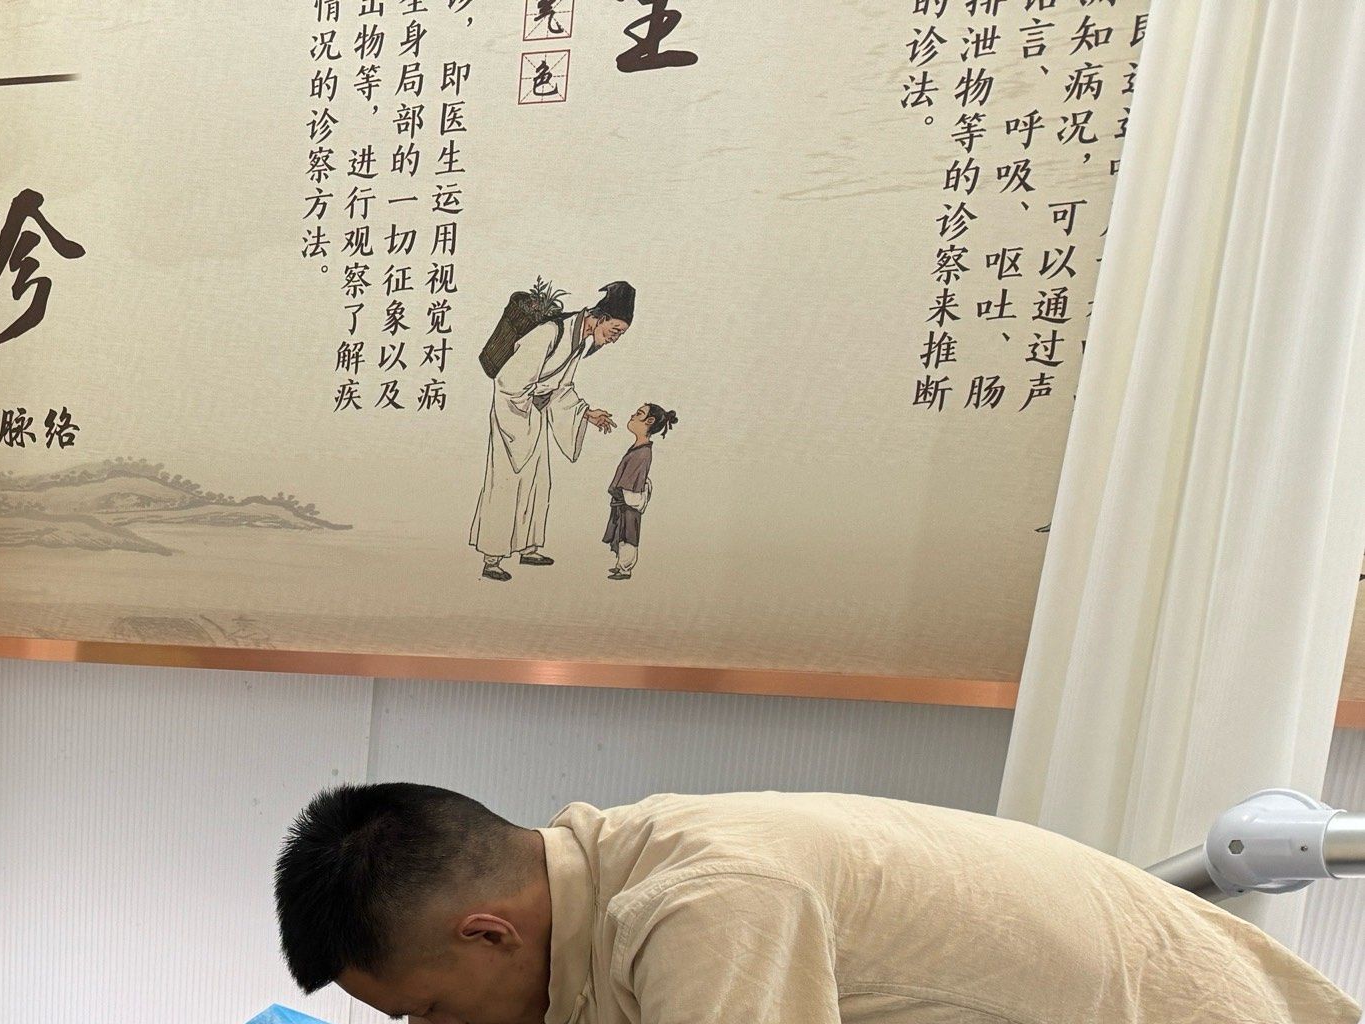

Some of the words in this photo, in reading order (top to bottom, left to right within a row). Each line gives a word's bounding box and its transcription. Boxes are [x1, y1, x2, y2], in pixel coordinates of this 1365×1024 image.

[964, 0, 1056, 411] 言、呼吸、呕吐、肠
[1019, 0, 1116, 412] 知病况，可以通过声
